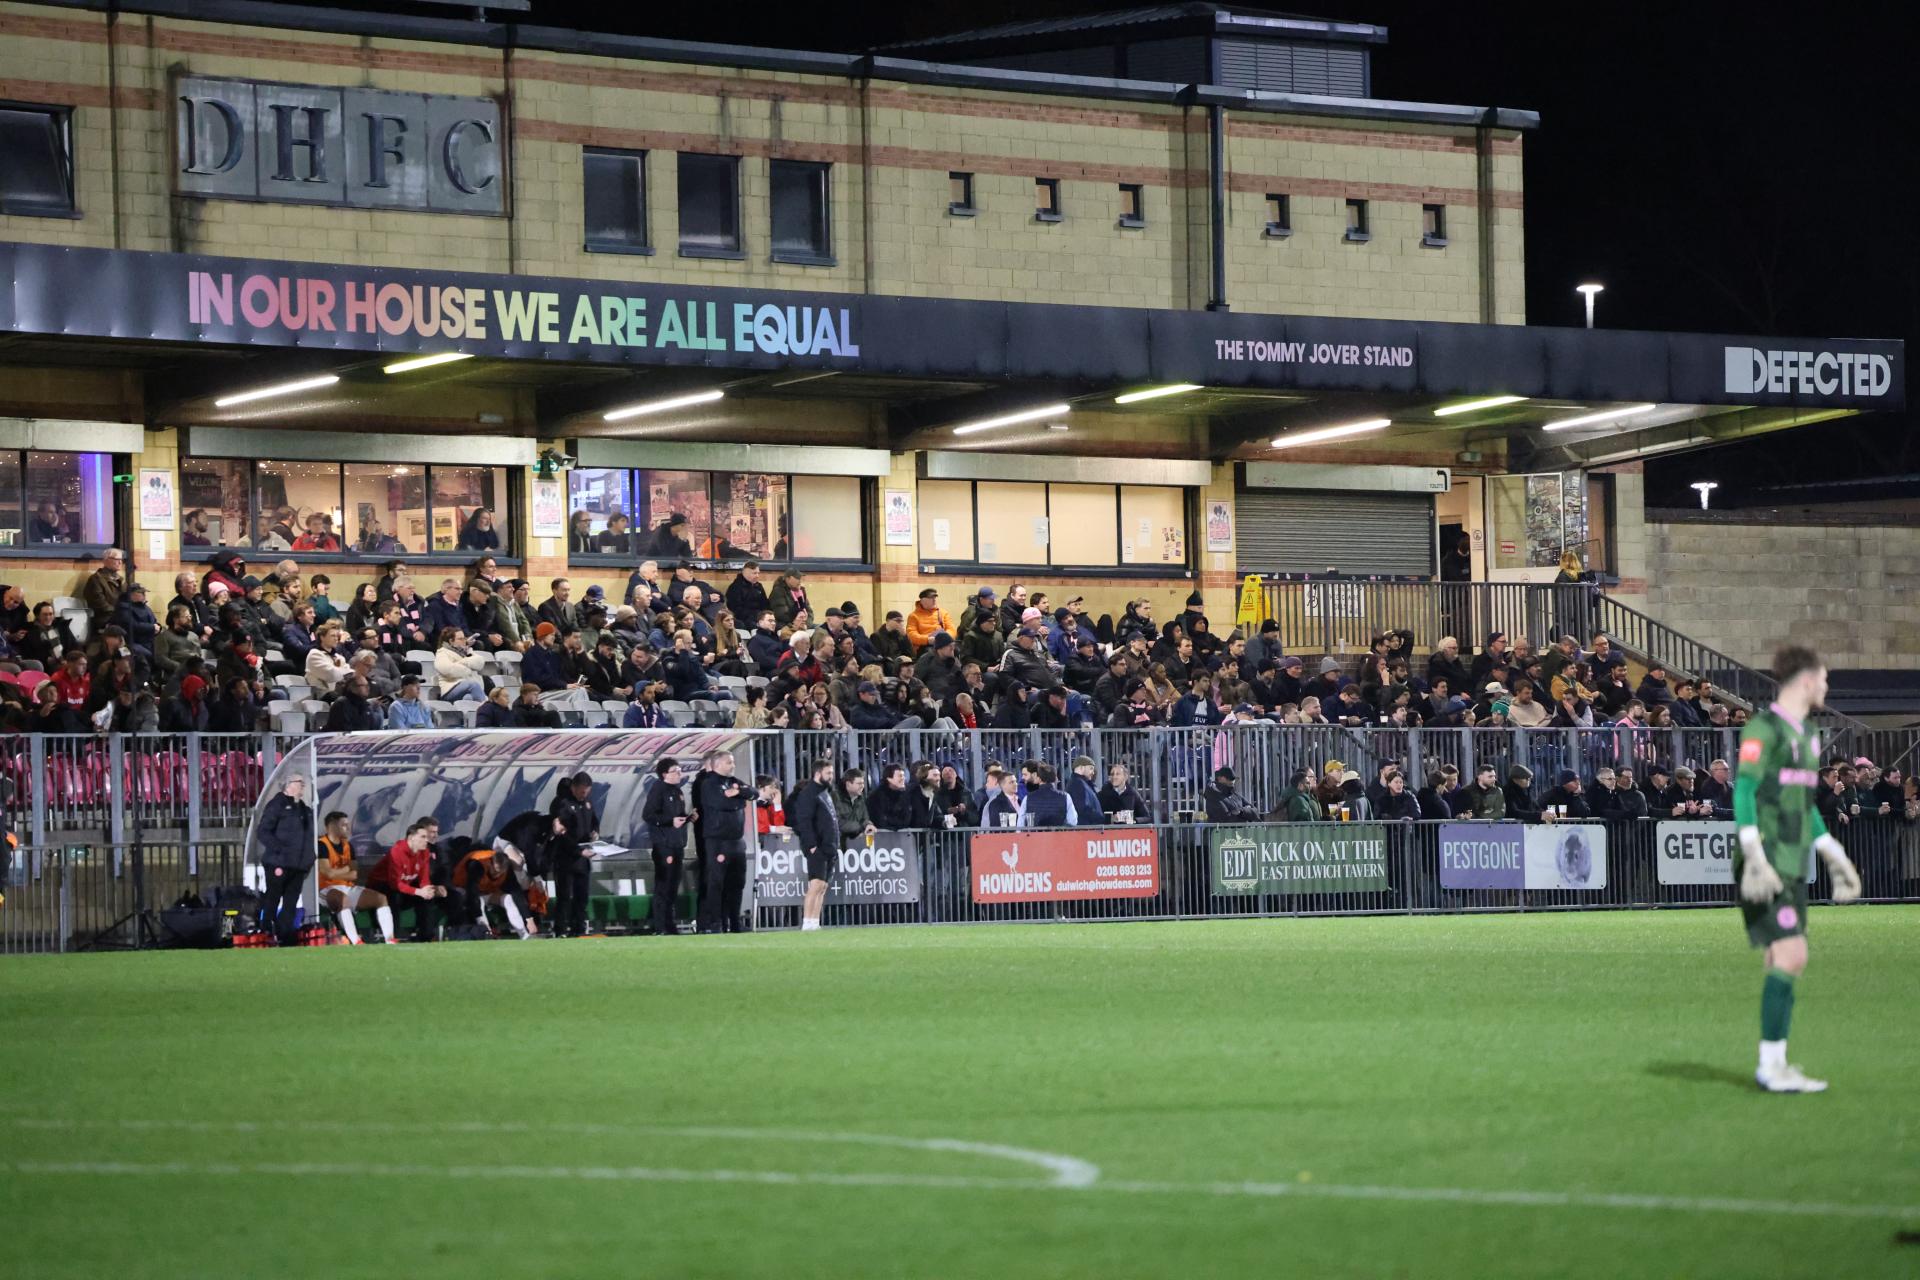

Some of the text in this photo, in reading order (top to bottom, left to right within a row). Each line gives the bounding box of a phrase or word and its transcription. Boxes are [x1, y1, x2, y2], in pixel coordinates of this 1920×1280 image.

[179, 95, 495, 194] DHFC
[189, 271, 859, 357] IN OUR HOUSE WE ARE ALL EQUAL
[1215, 339, 1413, 367] THE TOMMY JOVER STAND
[1725, 347, 1891, 396] DEFECTED
[1087, 838, 1151, 859] DULWICH
[1261, 839, 1385, 862] KICK ON AT THE
[1443, 841, 1520, 870] PESTGONE
[1096, 865, 1118, 877] 0208
[1119, 864, 1135, 876] 693
[1223, 848, 1255, 878] EDT
[1261, 862, 1385, 880] EAST DULWICH TAVERN
[845, 874, 908, 896] interiors
[979, 871, 1052, 894] HOWDENS
[1056, 878, 1153, 892] dulwich@howdens.com
